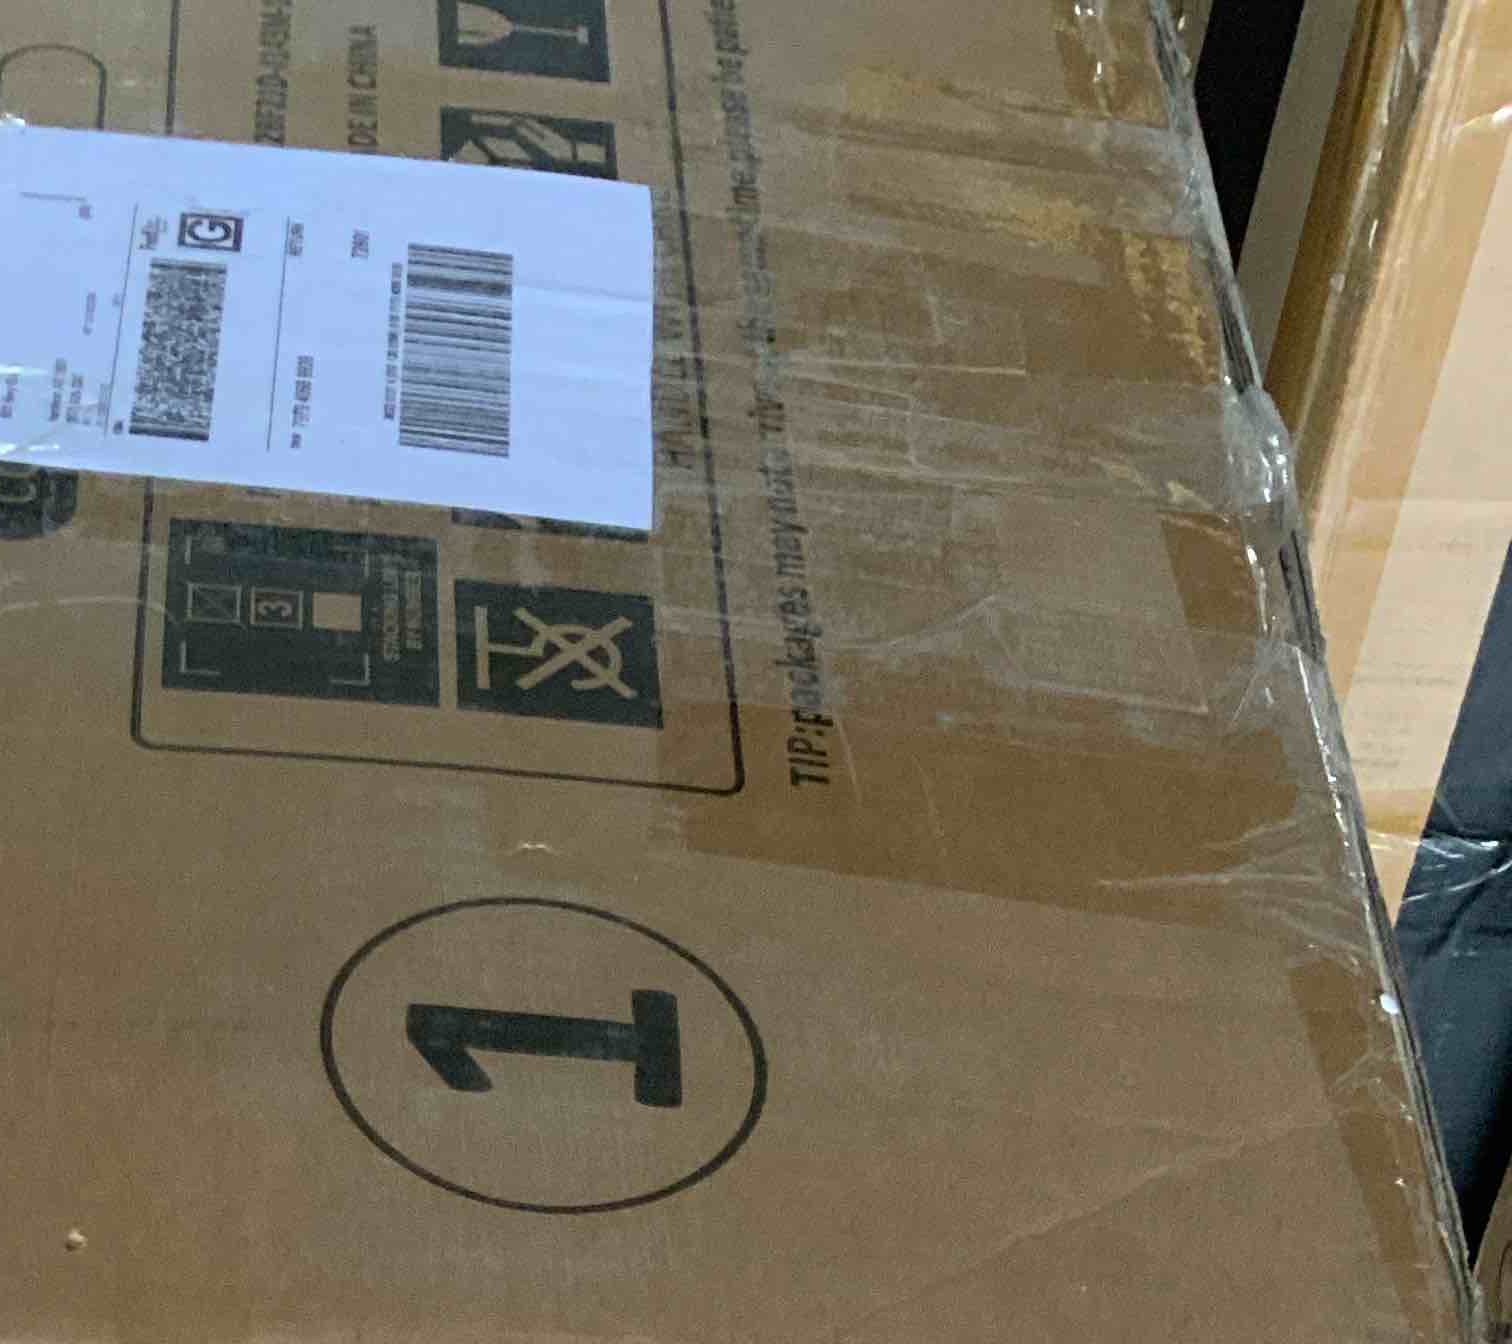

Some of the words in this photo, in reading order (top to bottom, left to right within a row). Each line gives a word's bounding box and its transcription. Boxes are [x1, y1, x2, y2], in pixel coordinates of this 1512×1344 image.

[187, 219, 233, 244] G
[257, 598, 289, 620] 3
[407, 989, 683, 1108] 1
